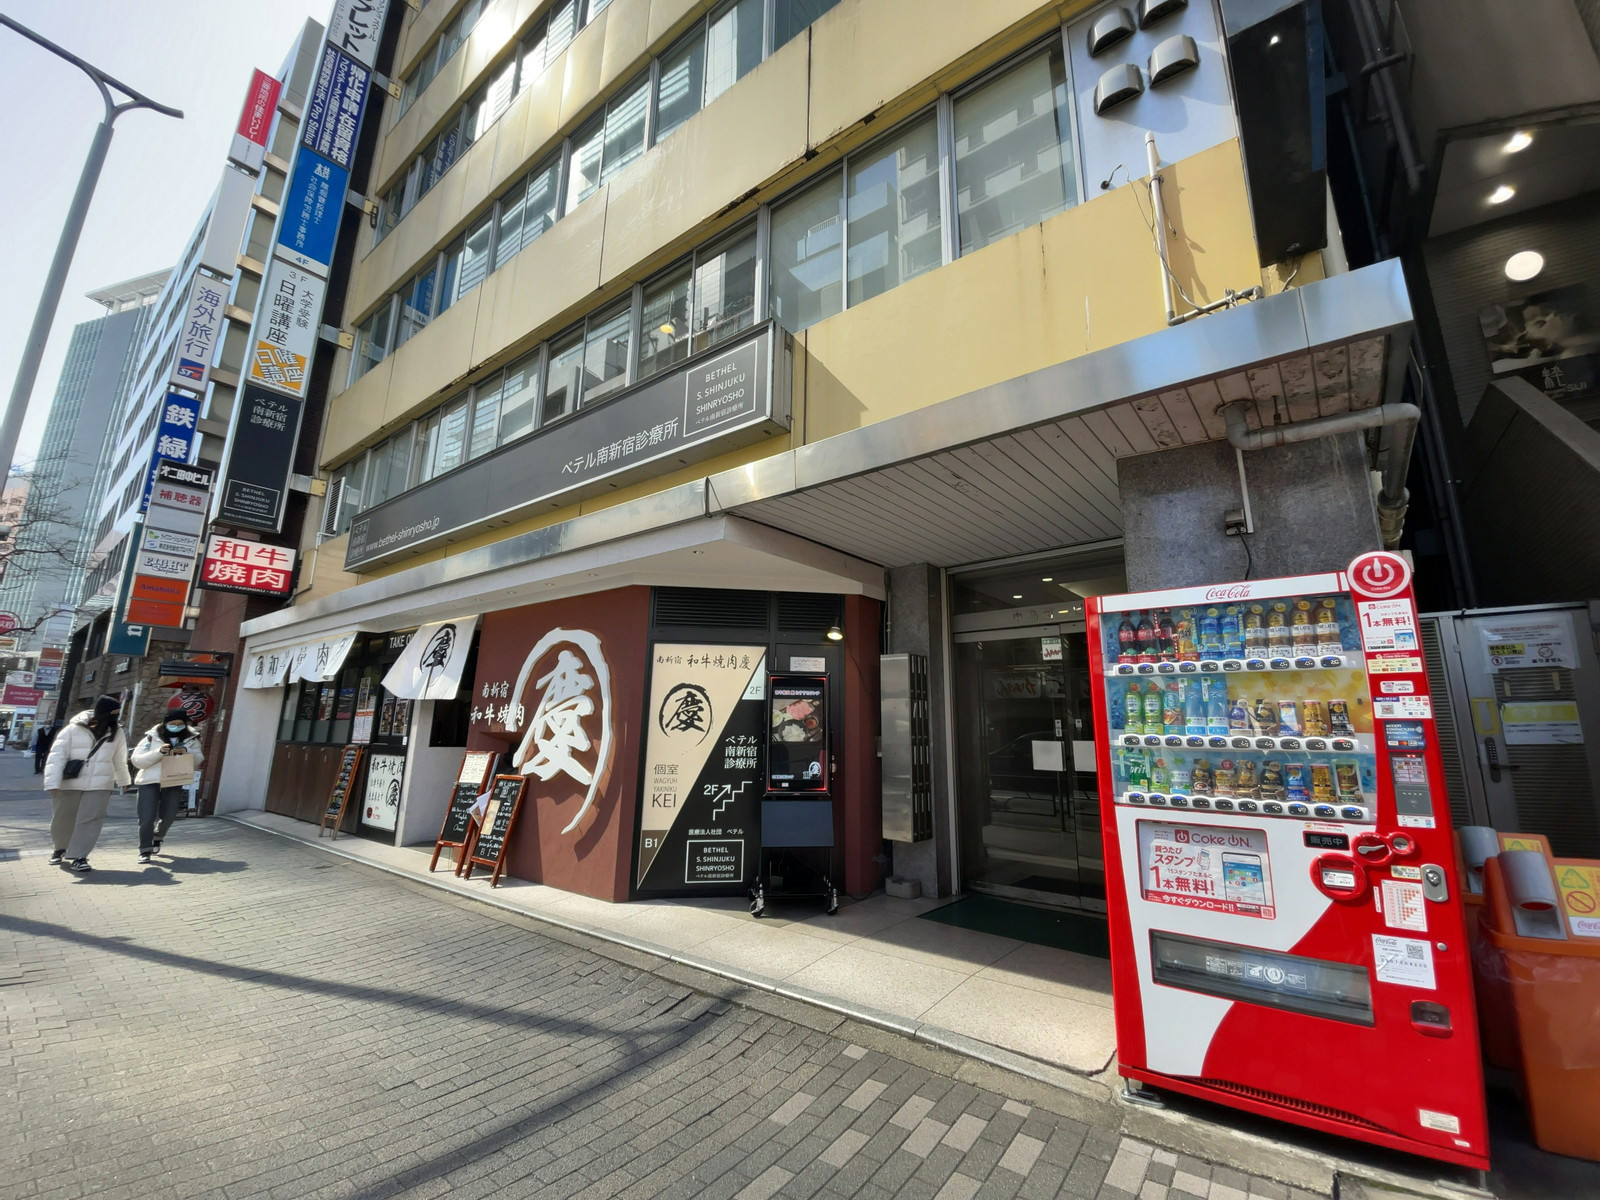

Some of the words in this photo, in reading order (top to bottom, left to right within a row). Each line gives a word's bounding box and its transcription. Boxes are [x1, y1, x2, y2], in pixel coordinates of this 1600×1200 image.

[295, 256, 309, 266] 4F
[266, 279, 297, 347] 日曜講座
[295, 289, 315, 331] 大学受験
[185, 286, 222, 357] 海外旅行
[705, 363, 737, 382] BETHEL
[704, 373, 746, 397] SHINJUKU
[255, 398, 288, 412] ベテル
[696, 389, 745, 415] SHINRYOSHO
[252, 405, 287, 422] 南新宿
[696, 401, 744, 425] ベテル南新宿診療所
[250, 414, 286, 431] 診療所
[561, 416, 679, 475] ベテル南新宿診療所
[159, 488, 202, 507] 補聴器
[365, 515, 440, 552] www.bethel-shinryosho.jp
[213, 540, 289, 565] 和牛
[208, 561, 285, 588] 焼肉
[1205, 584, 1250, 600] Coca-Cola
[1362, 612, 1412, 628] 1本無料!
[389, 636, 405, 648] TAKE
[656, 655, 682, 665] 南新宿
[481, 681, 510, 699] 南新宿
[750, 686, 761, 694] 2F
[470, 703, 525, 726] 和牛焼肉
[725, 735, 757, 744] ベテル
[725, 746, 757, 757] 南新宿
[653, 764, 679, 775] 個室
[724, 758, 757, 769] 診療所
[703, 784, 719, 795] 2F
[652, 794, 677, 808] KEI
[644, 838, 658, 848] B1
[1191, 833, 1225, 846] Coke
[1228, 835, 1250, 848] ON
[1310, 835, 1343, 846] 販売中
[1154, 845, 1182, 855] 買うたび
[1154, 853, 1195, 867] スタンプ
[1149, 865, 1215, 896] 1本無料!
[1162, 895, 1235, 912] 今すぐダウンロード!!
